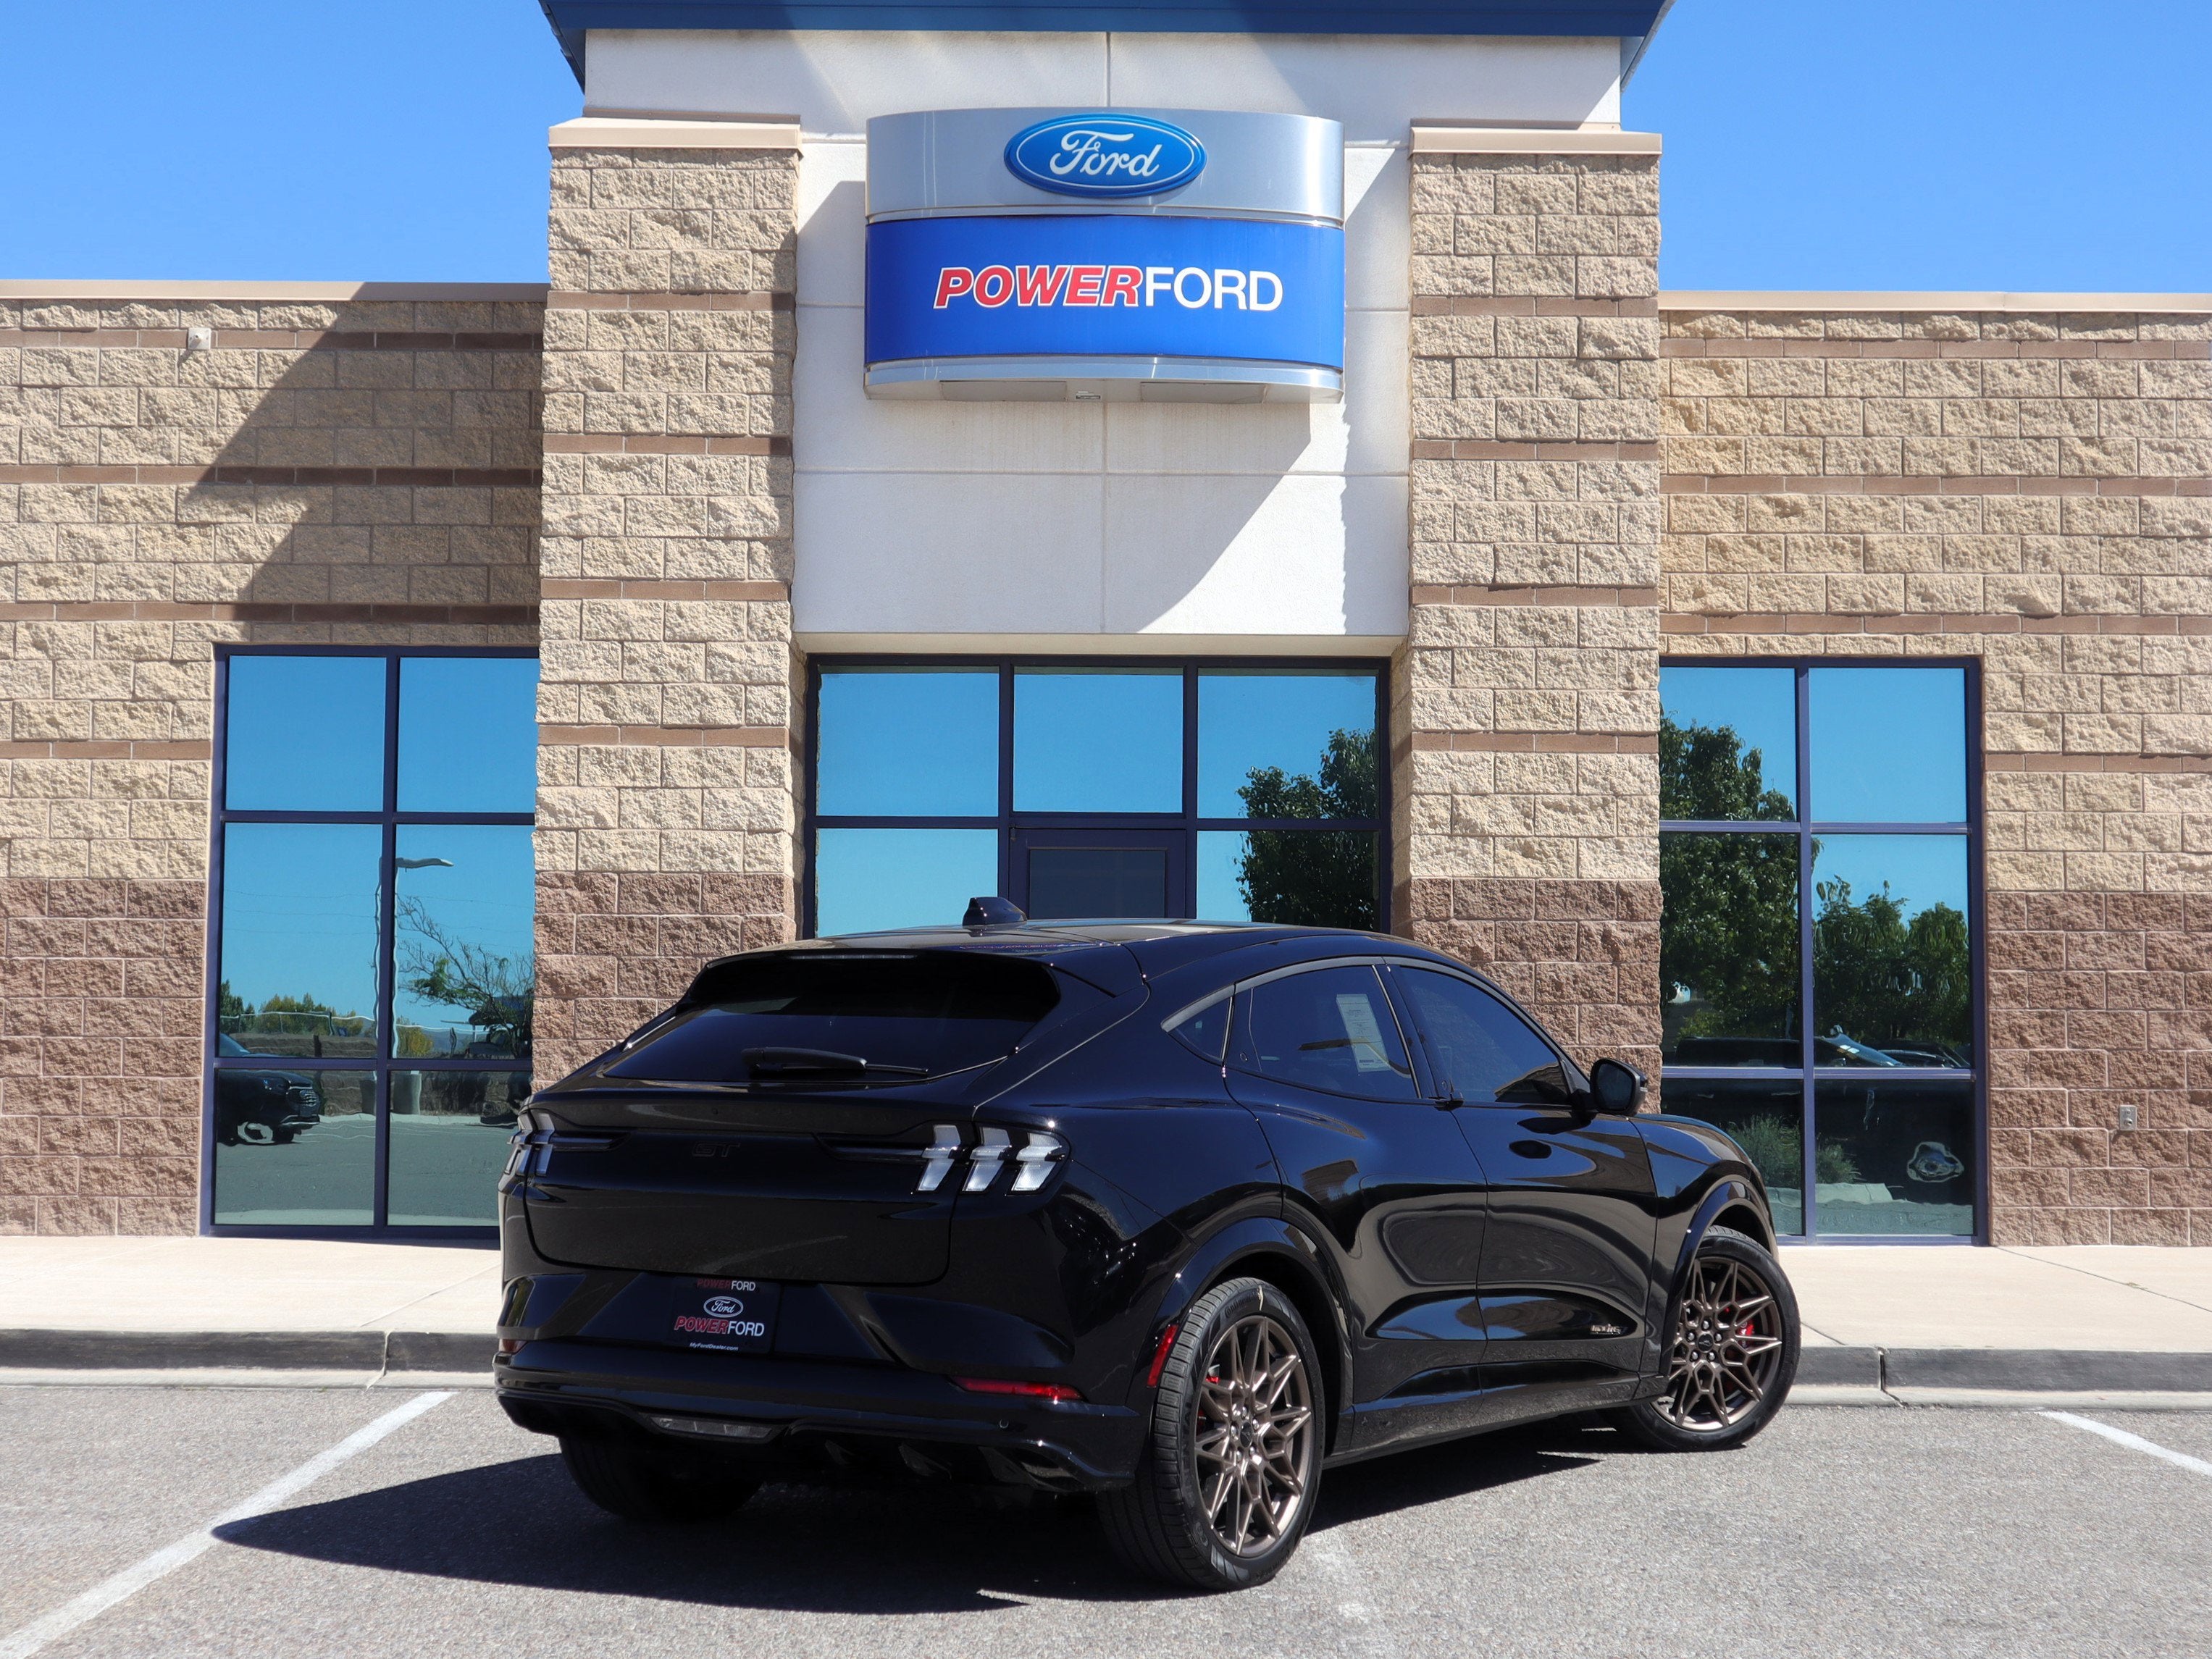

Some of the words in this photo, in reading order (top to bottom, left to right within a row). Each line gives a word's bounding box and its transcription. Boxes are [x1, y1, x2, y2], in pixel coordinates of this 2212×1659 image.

[1050, 130, 1162, 178] Ford
[933, 264, 1284, 311] POWERFORD
[692, 1141, 741, 1157] GT
[711, 1300, 735, 1314] Ford
